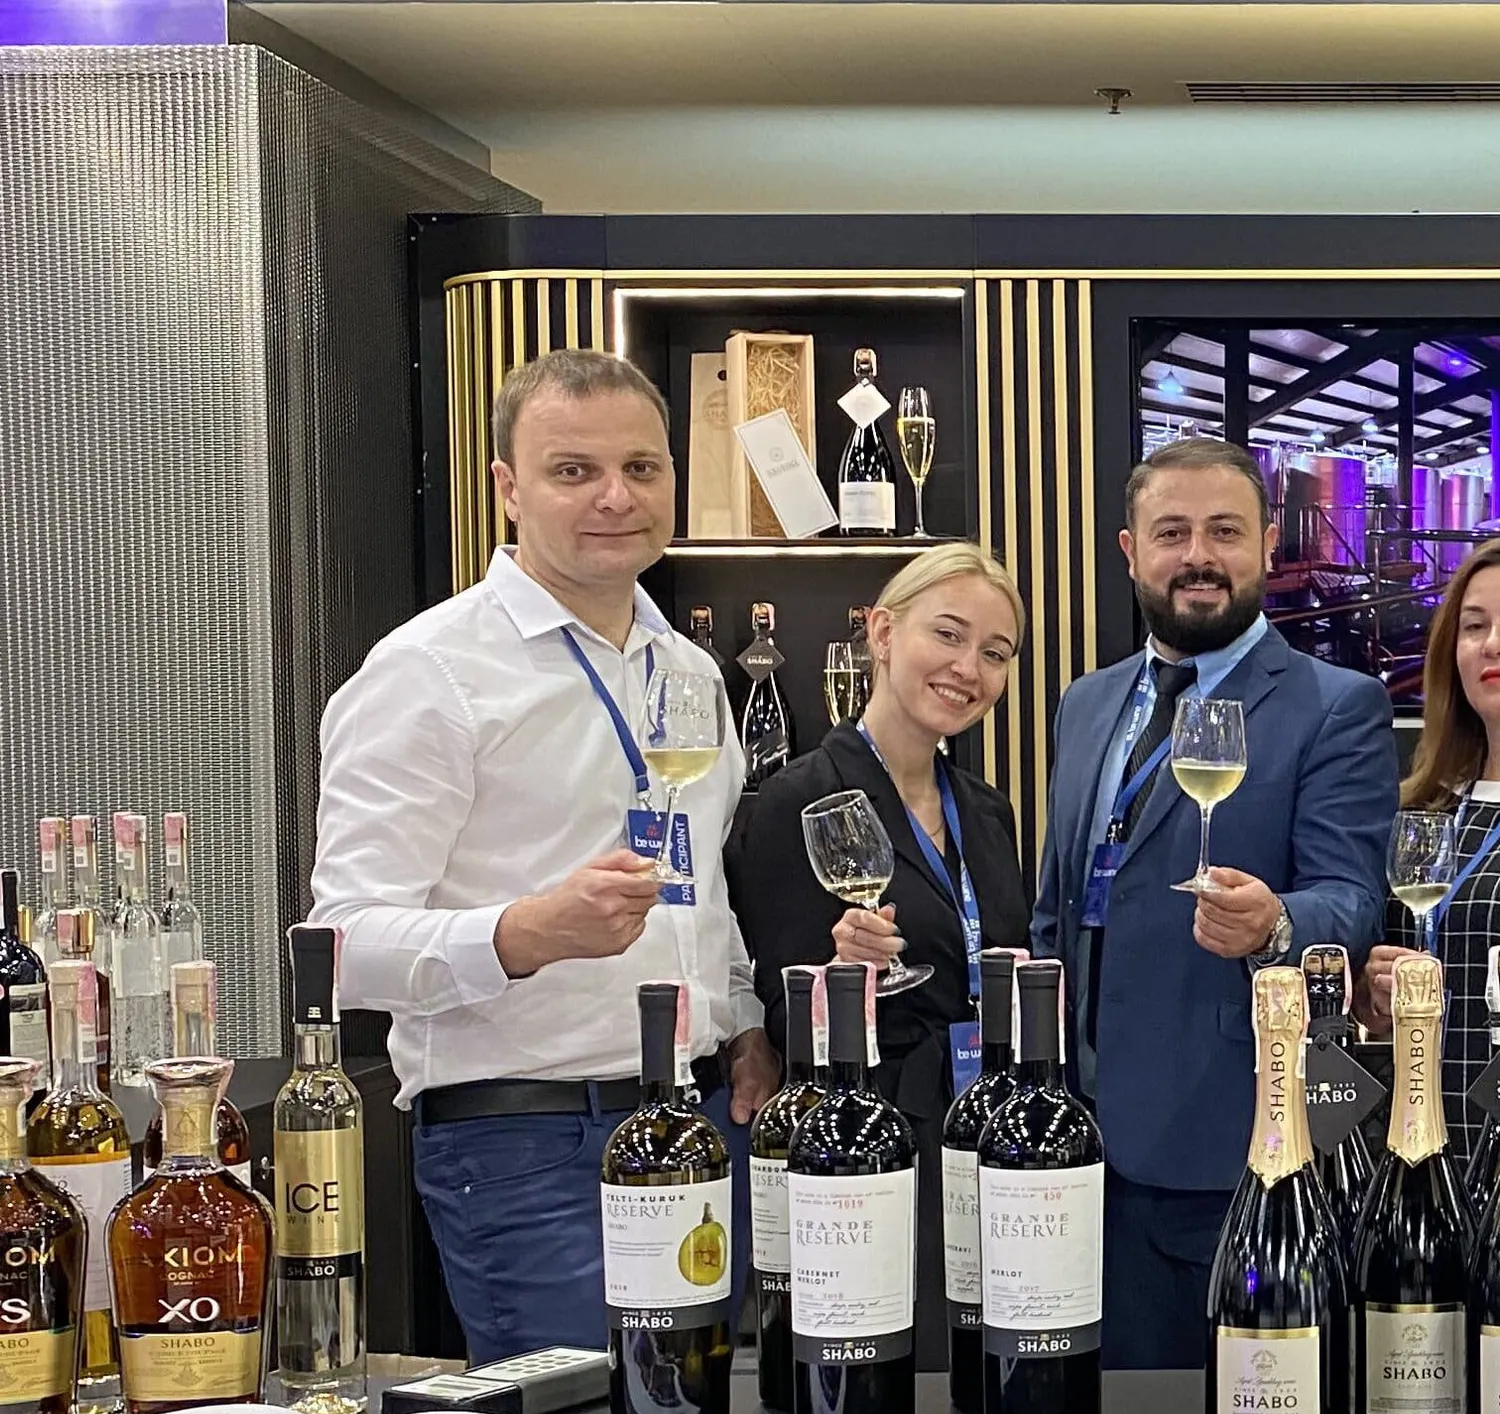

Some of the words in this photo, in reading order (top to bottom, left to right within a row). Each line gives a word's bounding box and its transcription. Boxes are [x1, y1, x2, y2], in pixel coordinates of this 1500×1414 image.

[675, 820, 692, 902] PATICIPANT
[1409, 1028, 1425, 1106] SHABO
[1270, 1041, 1285, 1122] SHABO
[1306, 1088, 1357, 1105] HABO
[286, 1181, 339, 1214] ICE
[606, 1203, 674, 1219] RESERVE
[990, 1212, 1069, 1223] GRANDE
[287, 1215, 341, 1225] WINE
[796, 1219, 874, 1230] GRANDE
[796, 1229, 873, 1246] RESERVE
[990, 1222, 1070, 1239] RESERVE
[287, 1264, 336, 1277] SHABO
[0, 1298, 31, 1324] S
[158, 1296, 220, 1324] XO
[621, 1316, 674, 1329] SHABO
[0, 1337, 29, 1350] ABO
[160, 1336, 215, 1349] SHABO
[1018, 1339, 1071, 1353] SHABO
[822, 1347, 877, 1361] SHABO
[1383, 1366, 1446, 1380] SHABO
[1233, 1394, 1298, 1409] SHABO
